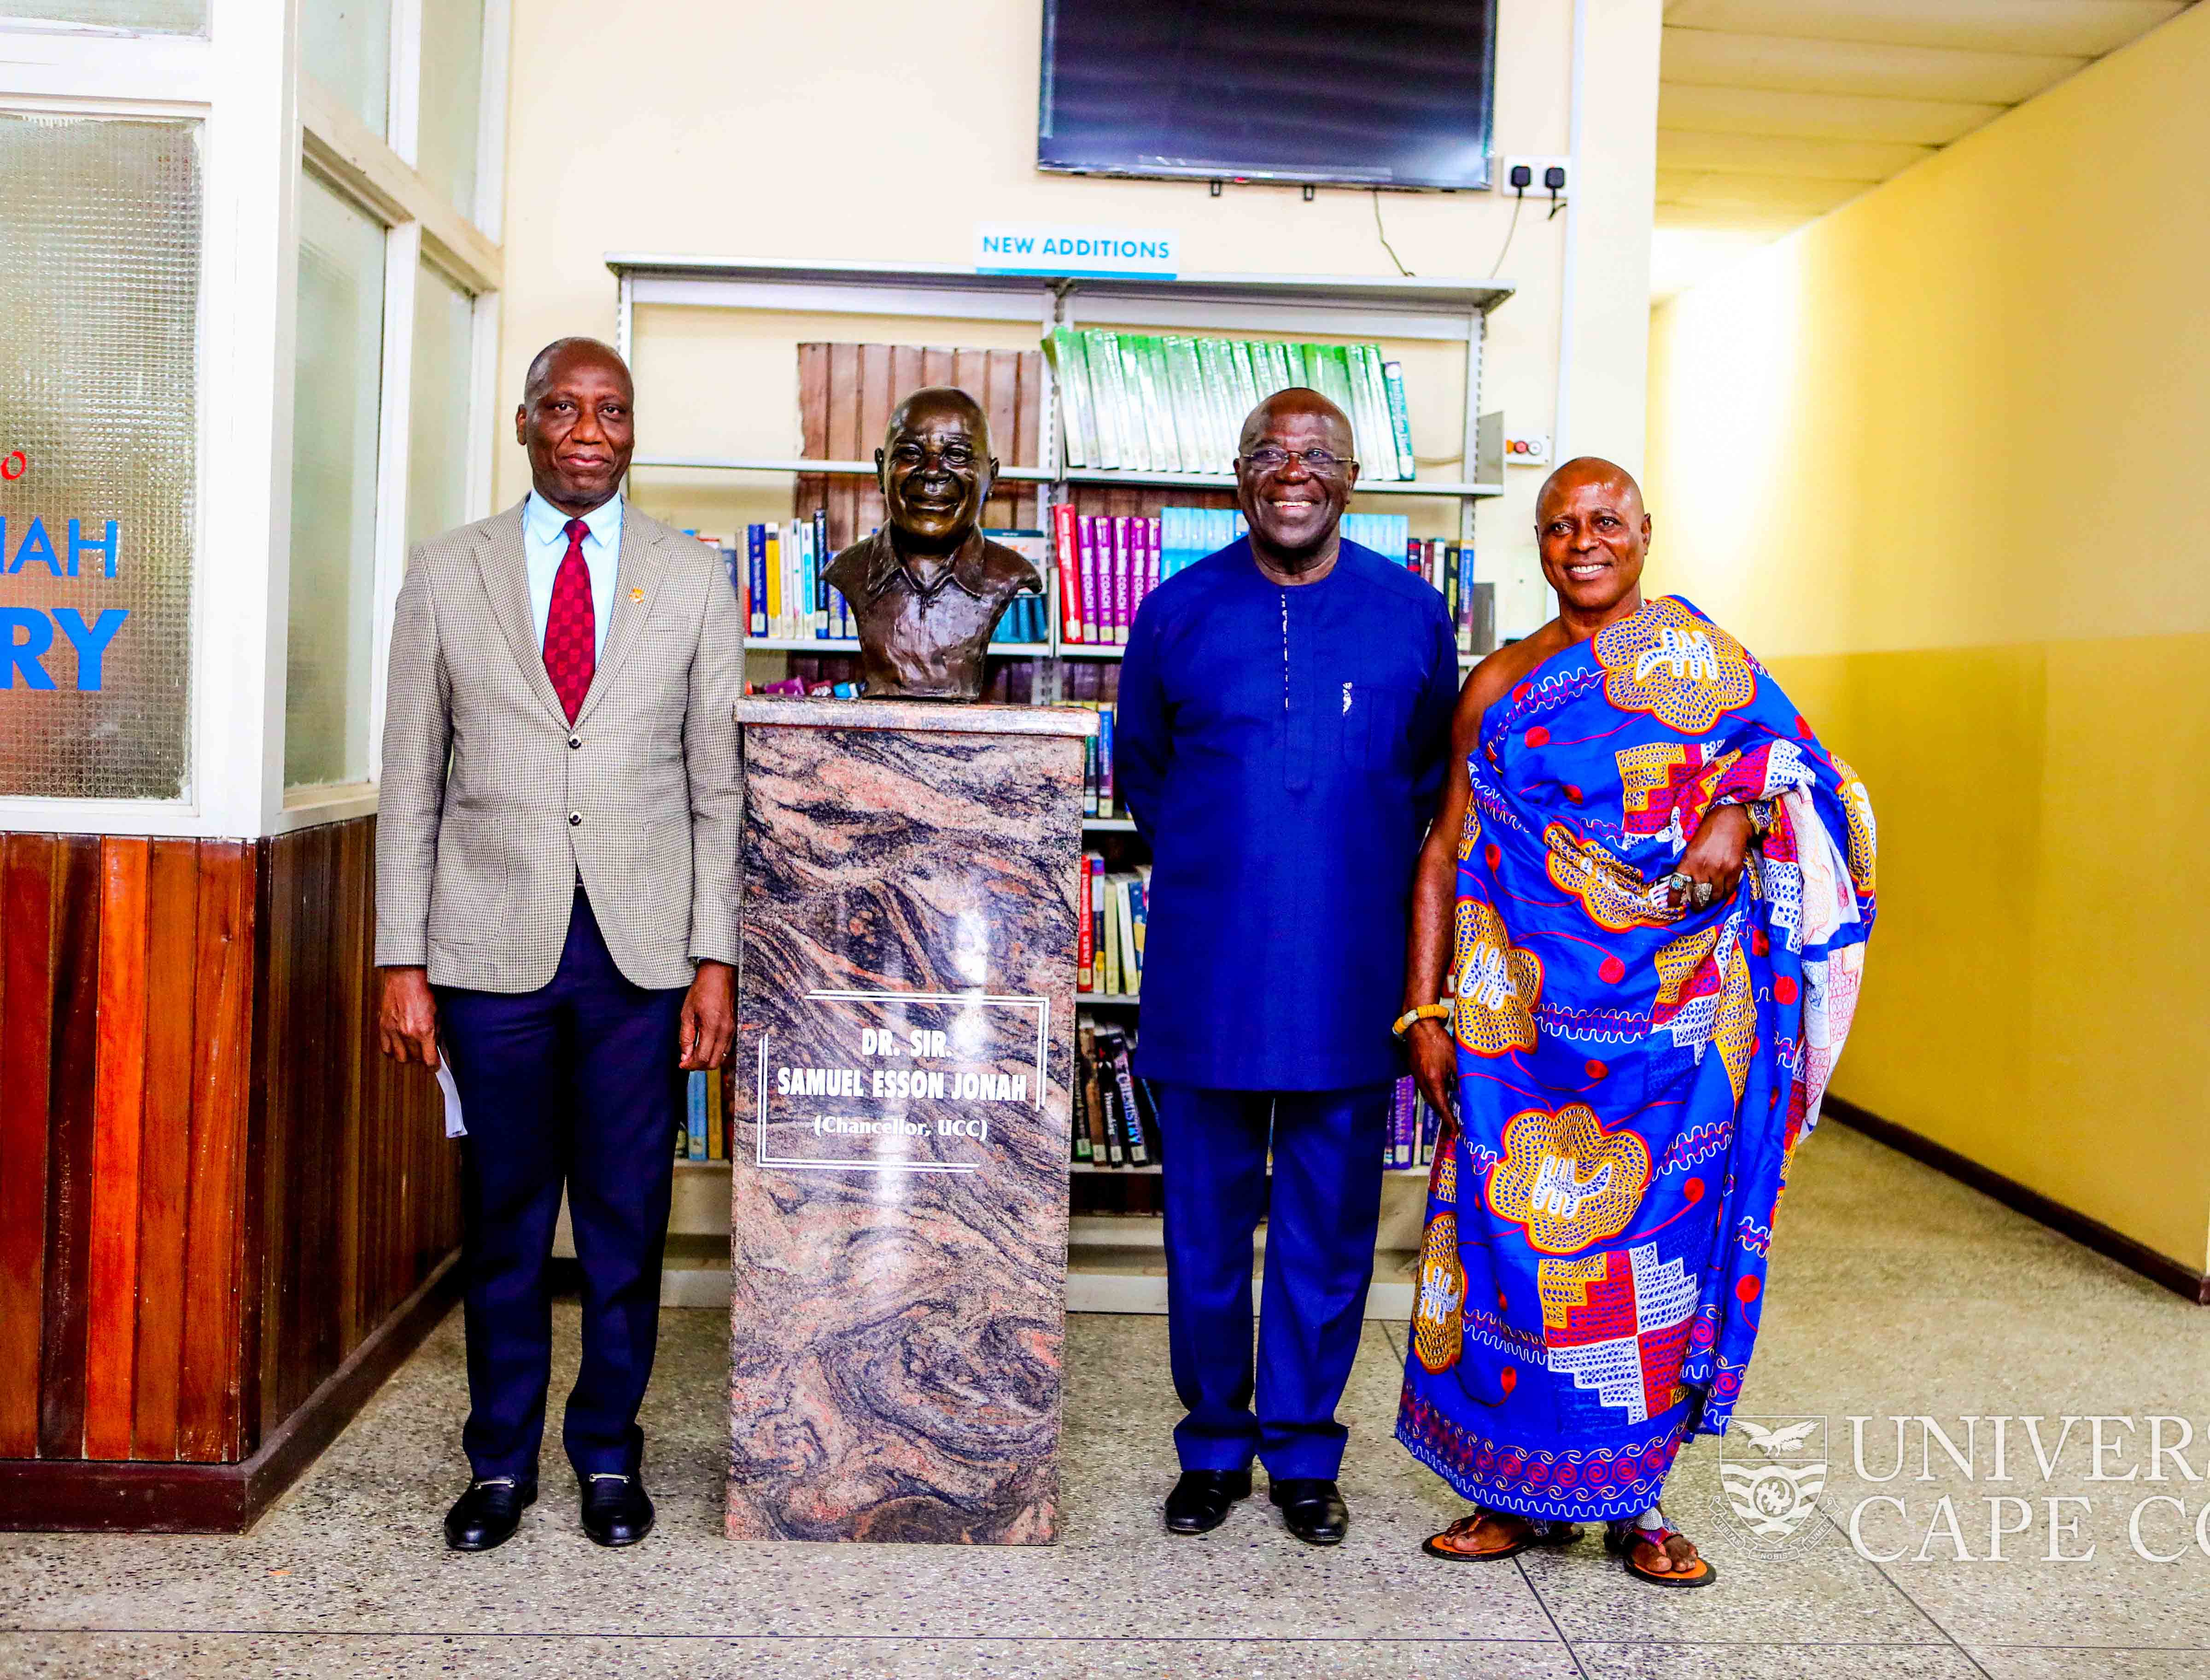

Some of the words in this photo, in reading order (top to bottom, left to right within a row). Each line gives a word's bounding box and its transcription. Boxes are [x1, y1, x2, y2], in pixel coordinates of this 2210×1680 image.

[983, 236, 1035, 254] NEW
[1043, 238, 1170, 258] ADDITIONS
[862, 1028, 900, 1056] DR.
[910, 1029, 952, 1057] SIR.
[778, 1068, 864, 1097] SAMUEL
[872, 1070, 944, 1099] ESSON
[951, 1073, 1027, 1101] JONAH
[814, 1114, 931, 1138] (Chancellor,
[938, 1119, 988, 1141] UCC)
